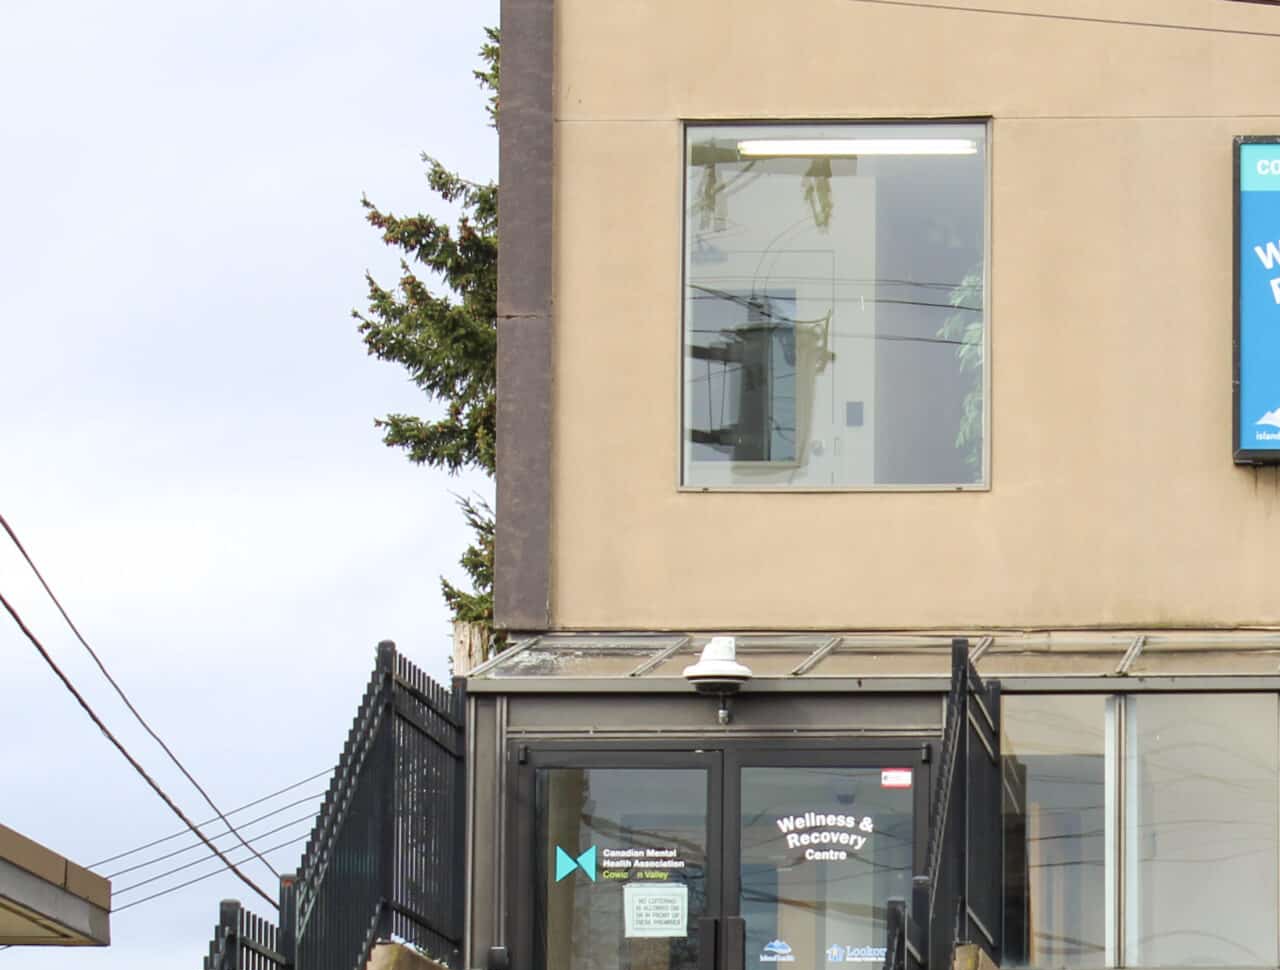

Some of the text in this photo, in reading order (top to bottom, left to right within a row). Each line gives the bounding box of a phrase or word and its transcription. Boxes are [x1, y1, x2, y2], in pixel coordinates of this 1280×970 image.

[776, 811, 874, 833] Wellness &
[786, 831, 867, 850] Recovery
[603, 848, 677, 857] Canadian Mental
[805, 848, 847, 860] Centre
[603, 859, 685, 868] Health Association
